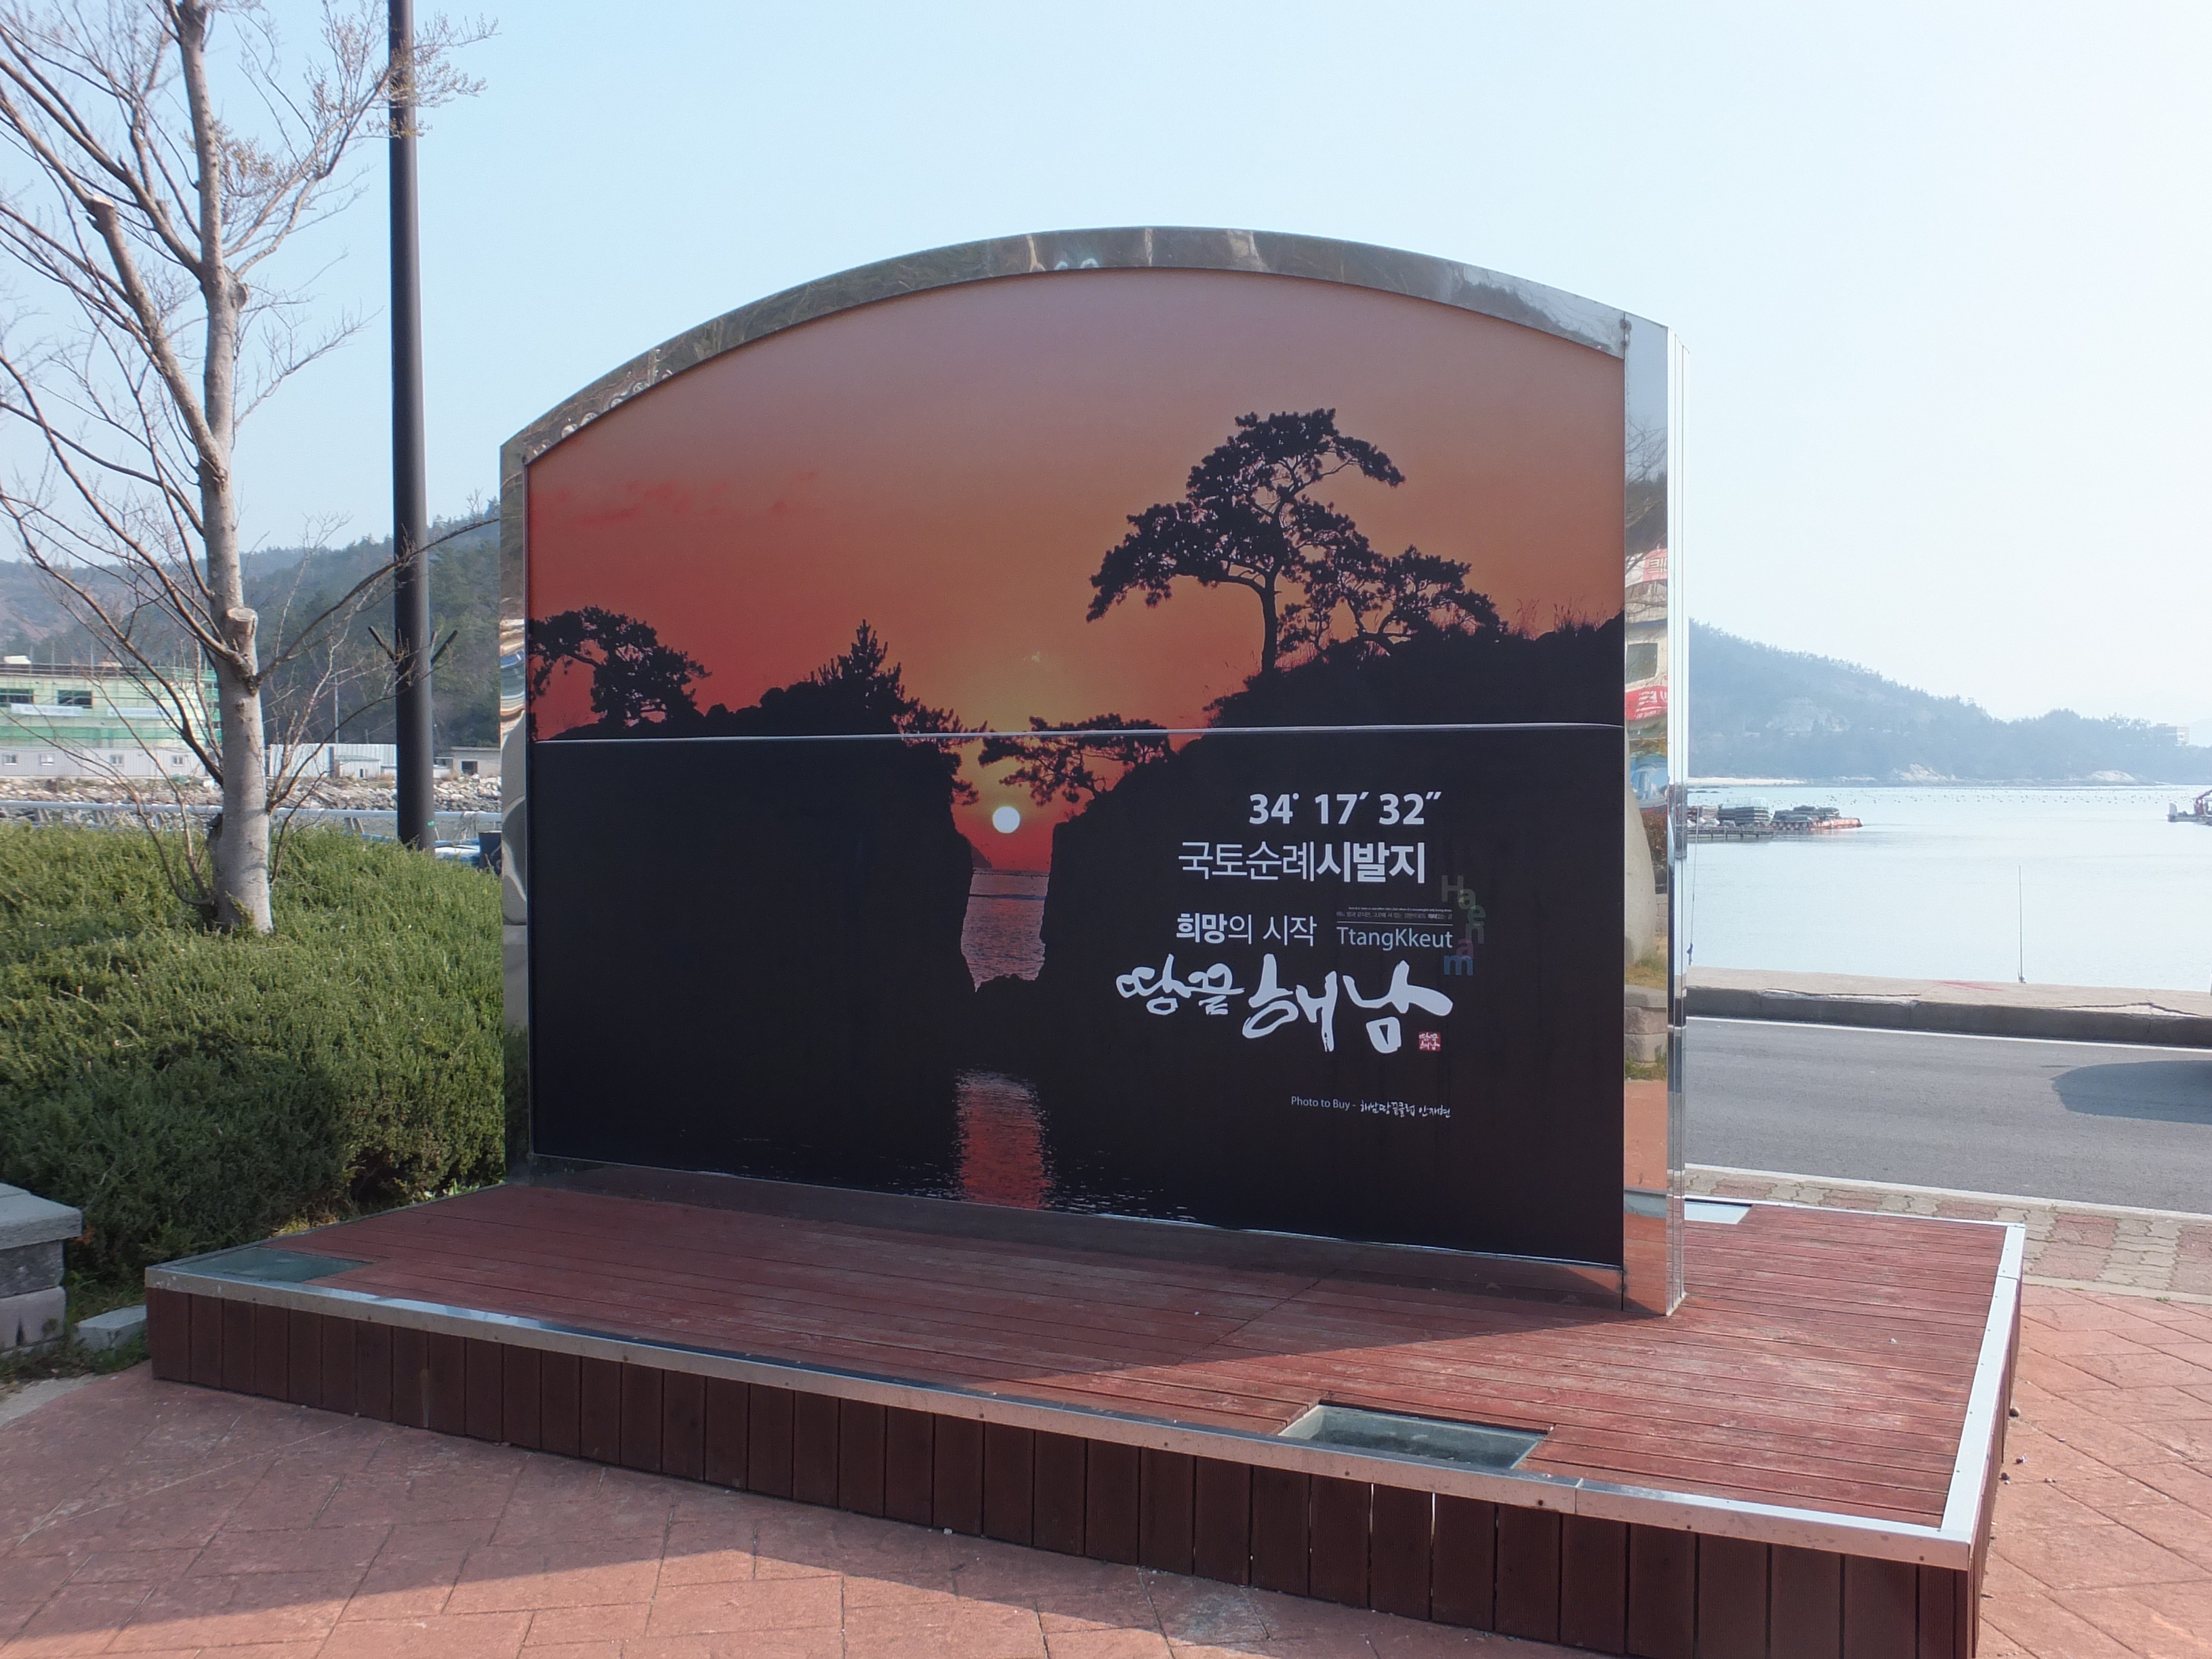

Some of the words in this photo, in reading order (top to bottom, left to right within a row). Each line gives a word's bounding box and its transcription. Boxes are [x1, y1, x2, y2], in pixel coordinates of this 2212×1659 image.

[1176, 912, 1252, 945] 희망의
[1263, 915, 1317, 947] 시작
[1336, 926, 1453, 951] TtangKkeut
[1291, 1096, 1319, 1107] Photo
[1321, 1099, 1331, 1108] to
[1333, 1099, 1351, 1111] Buy
